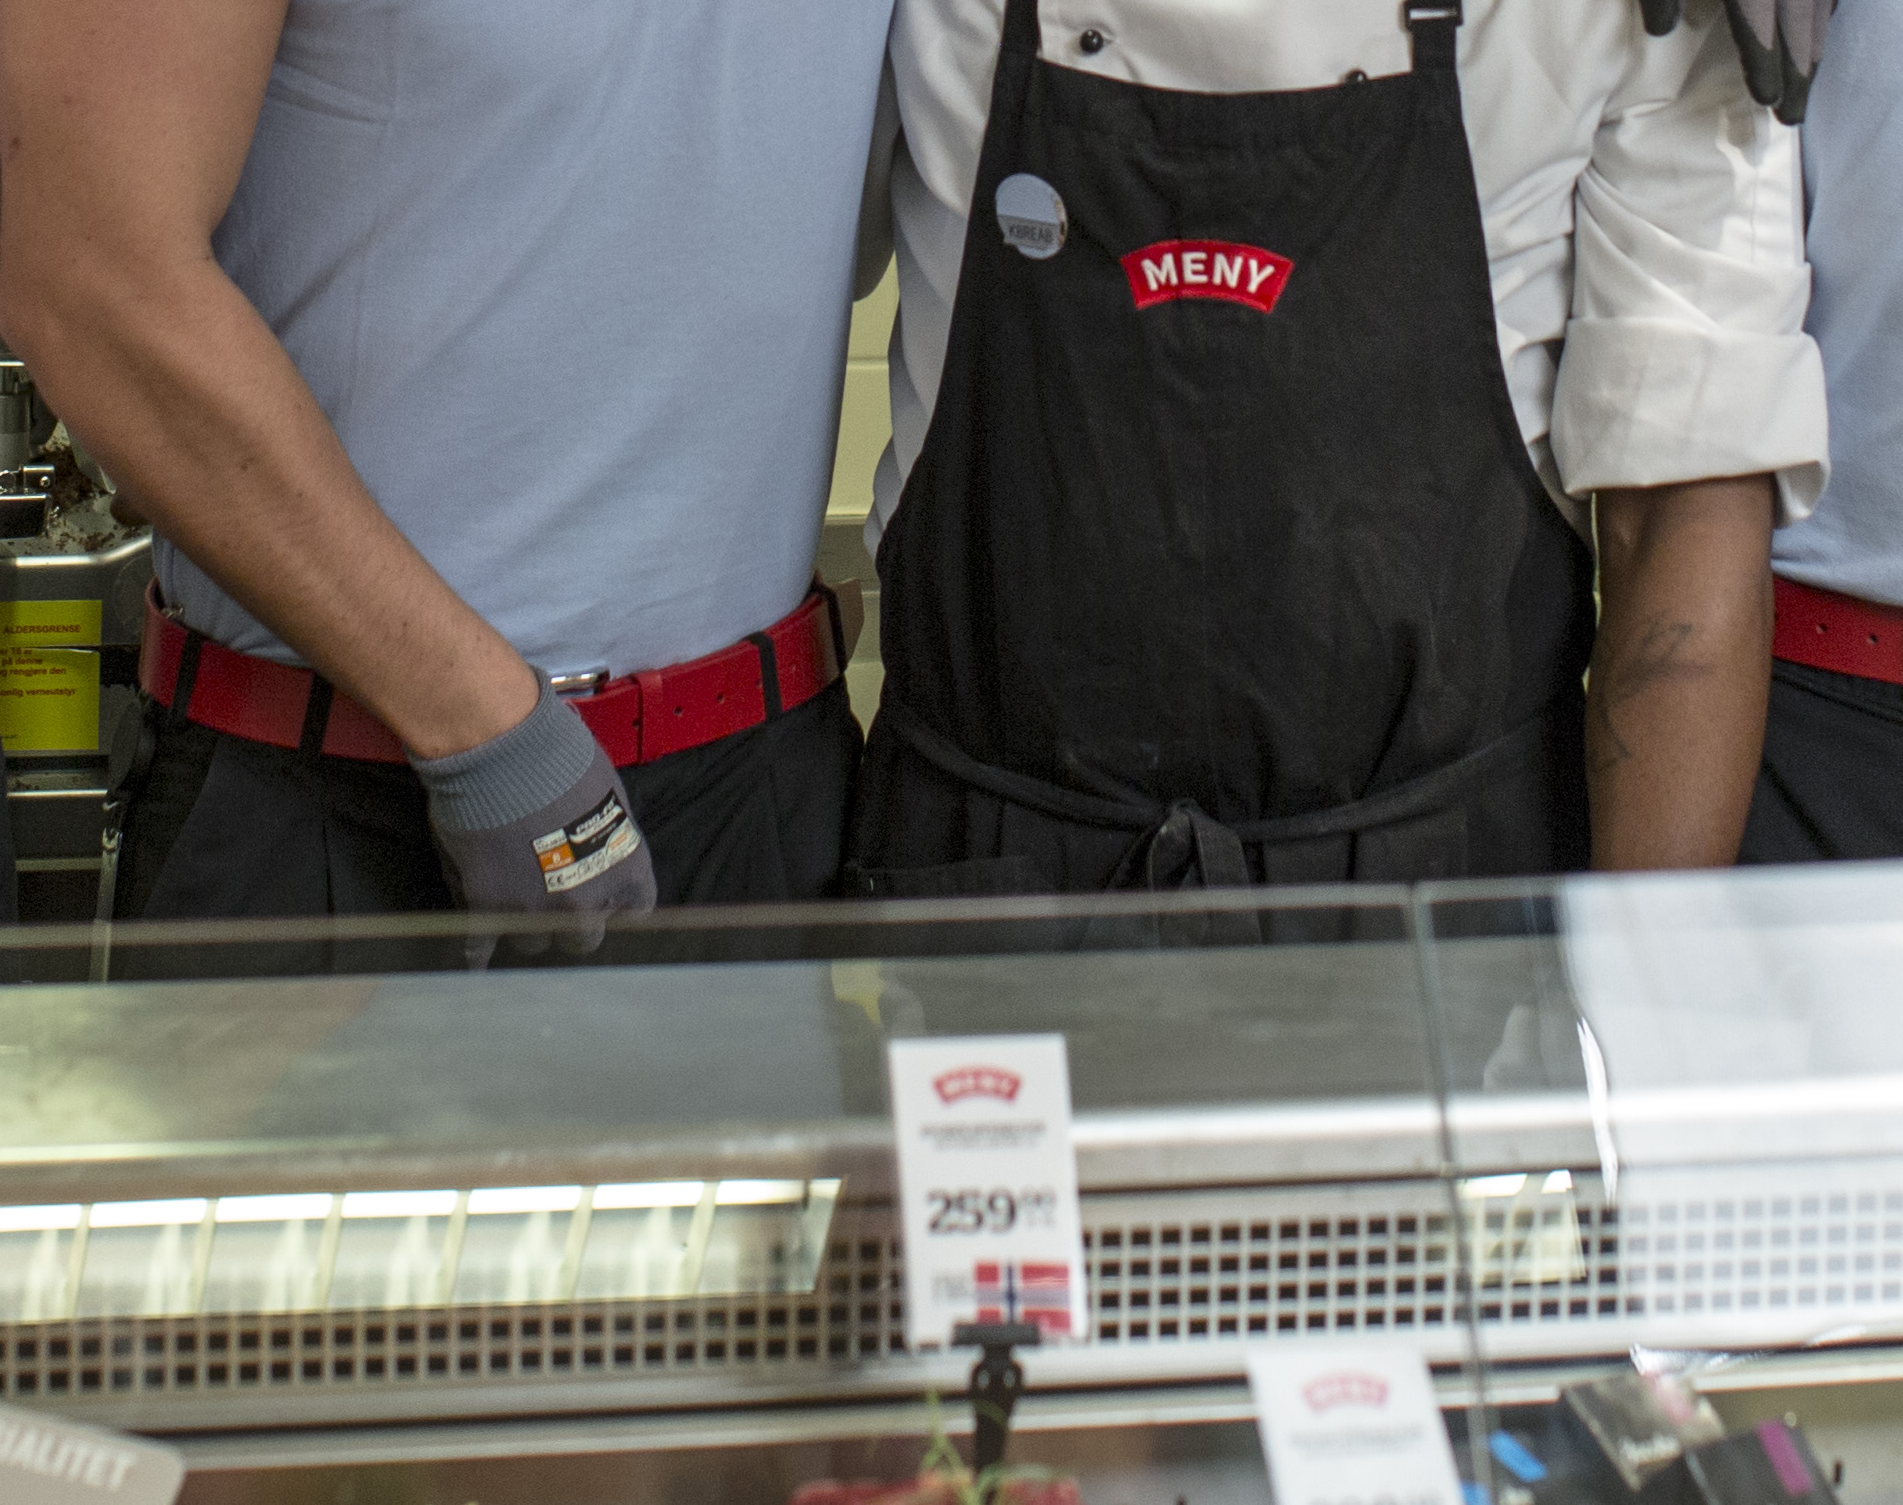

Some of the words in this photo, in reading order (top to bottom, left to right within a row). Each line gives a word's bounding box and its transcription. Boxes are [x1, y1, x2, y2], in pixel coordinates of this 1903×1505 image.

[1140, 251, 1276, 294] MENY
[3, 624, 81, 634] ALDERSGRENSE
[927, 1188, 1016, 1235] 259
